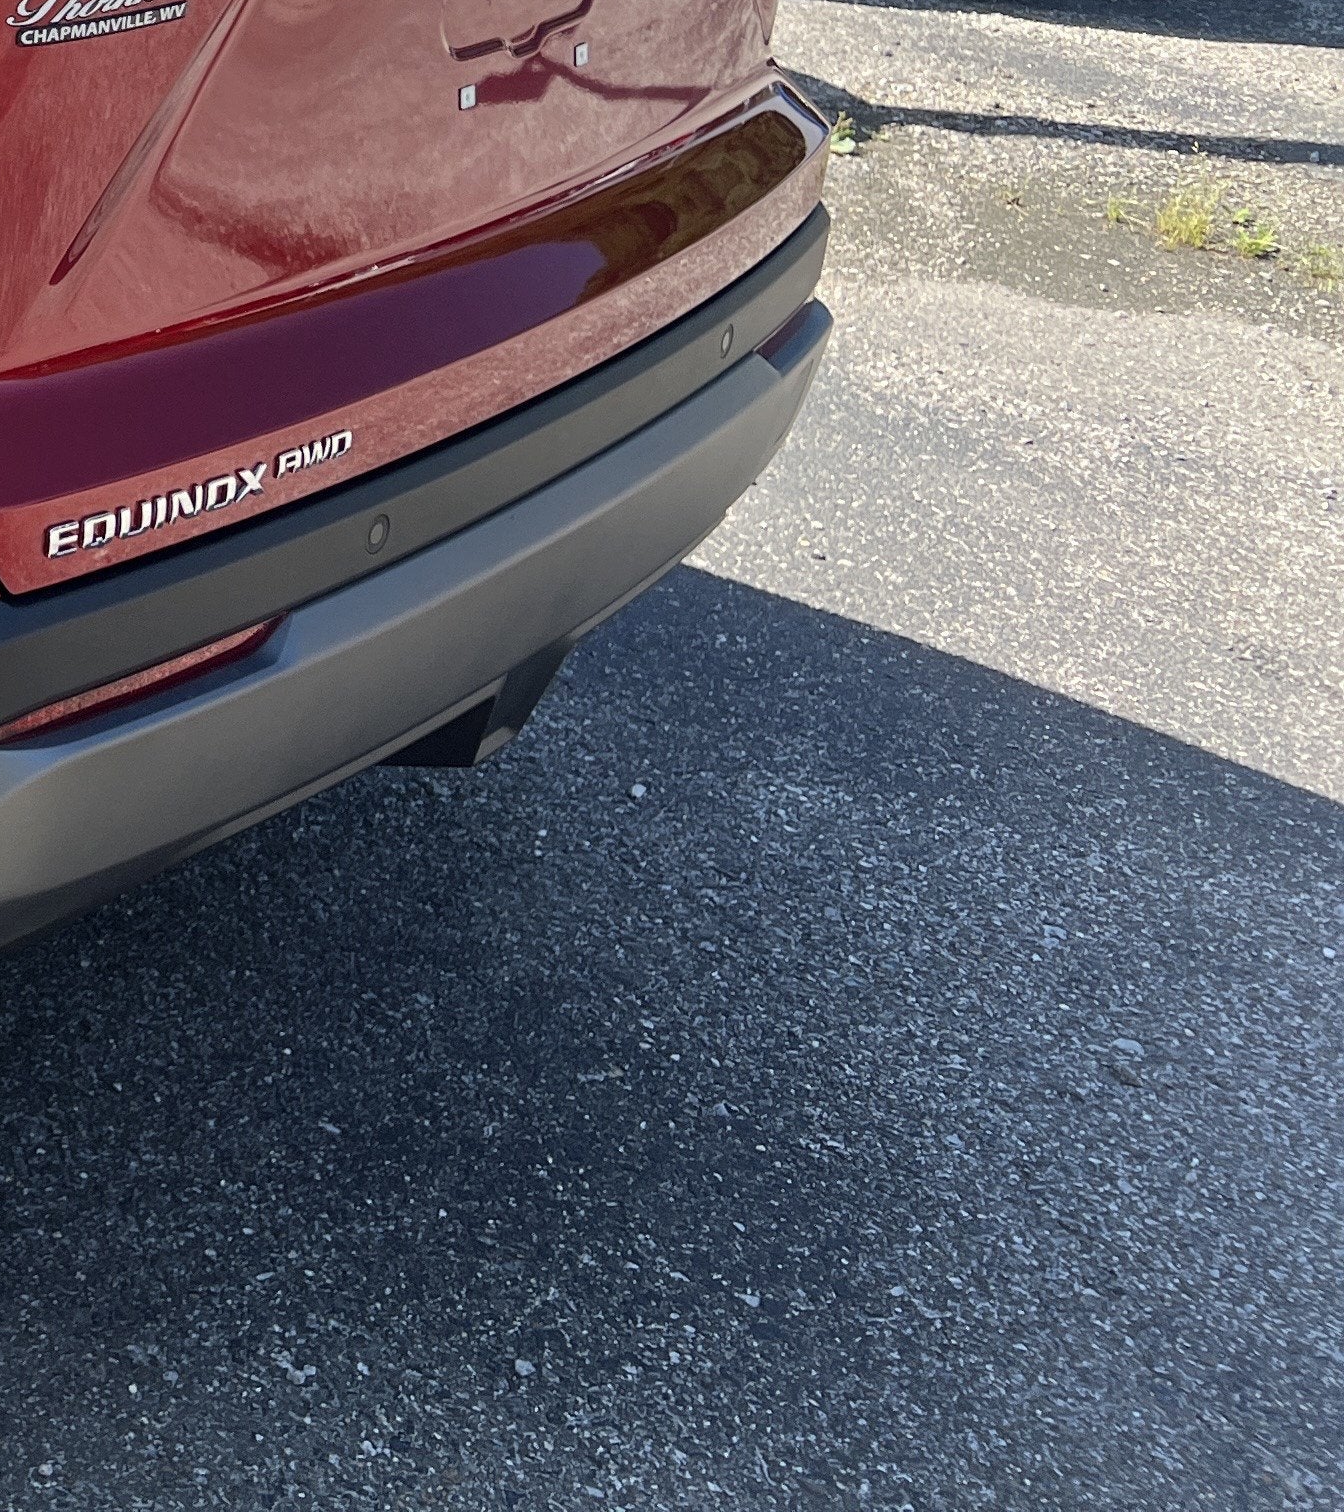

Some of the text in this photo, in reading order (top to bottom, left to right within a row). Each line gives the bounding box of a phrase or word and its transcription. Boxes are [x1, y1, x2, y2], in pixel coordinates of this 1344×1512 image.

[20, 2, 187, 46] CHAPMANVILLE, WV
[45, 428, 353, 559] EQUINOX AWD
